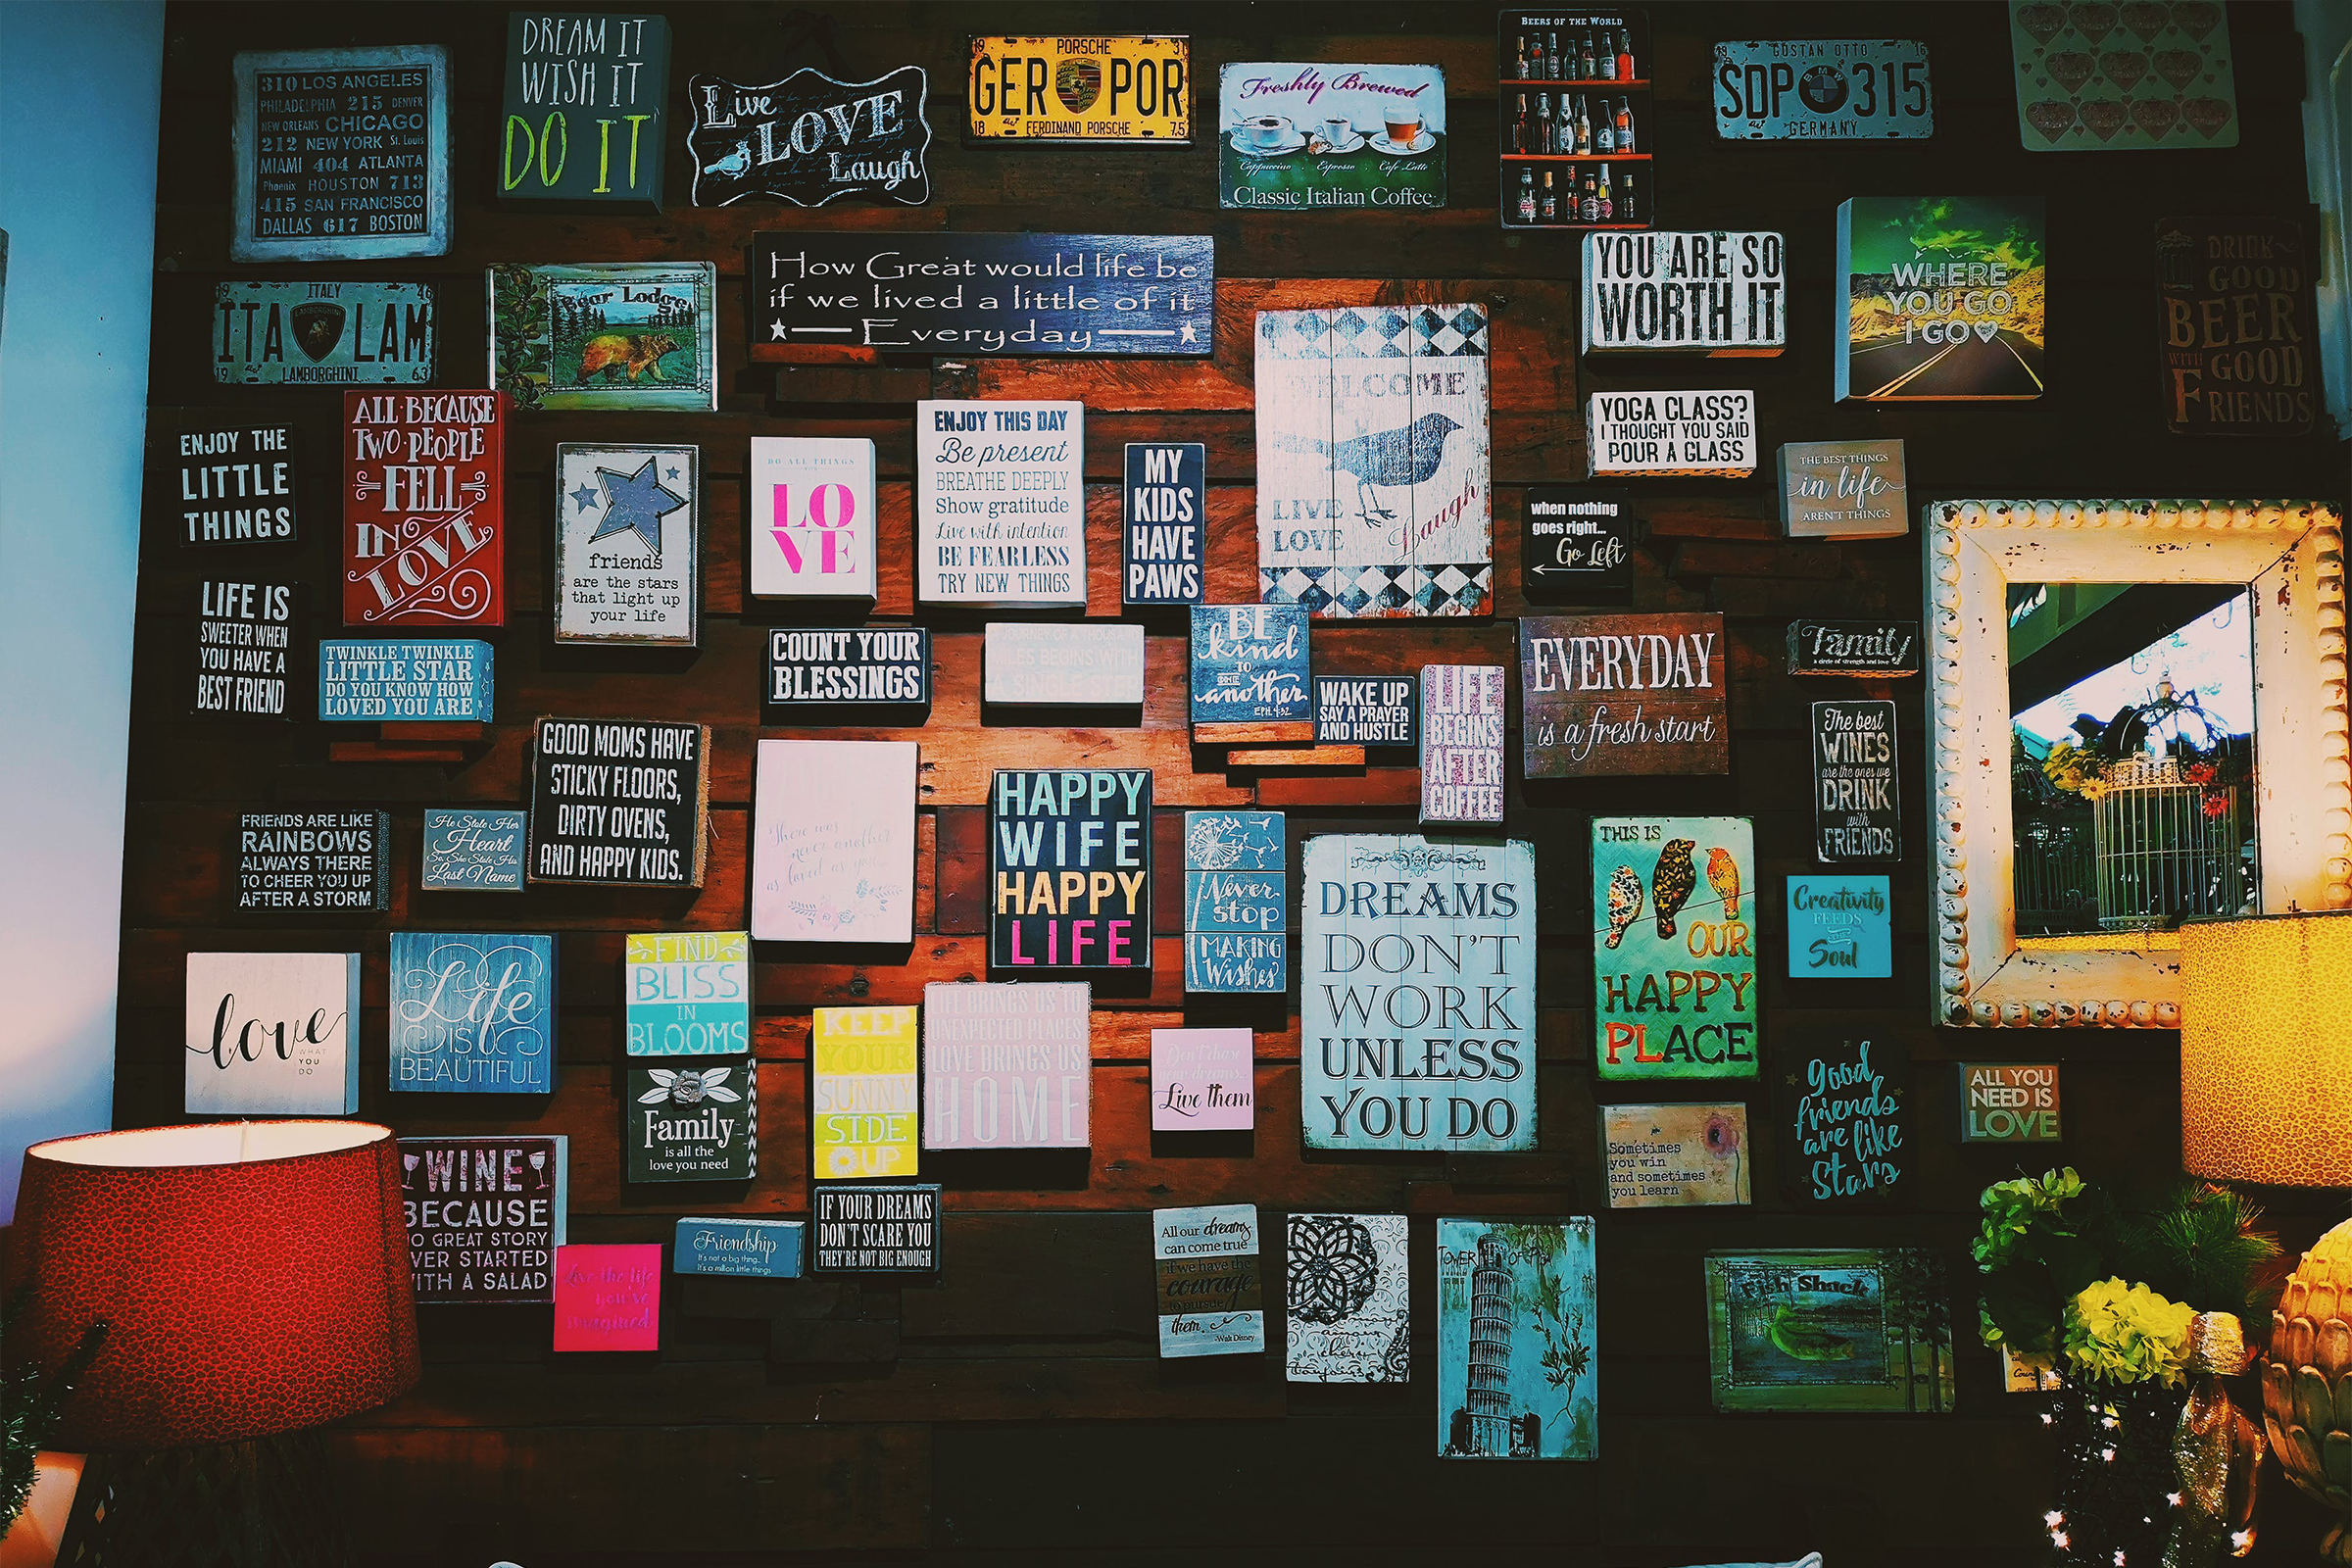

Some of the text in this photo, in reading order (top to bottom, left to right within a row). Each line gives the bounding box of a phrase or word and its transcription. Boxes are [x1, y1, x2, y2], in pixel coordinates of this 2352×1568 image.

[522, 19, 647, 58] DREAM IT
[1056, 39, 1111, 54] PORSCHE
[262, 74, 423, 92] 310 LOS ANGELES
[520, 60, 643, 107] WISH IT
[974, 58, 1184, 117] GER POR
[1240, 67, 1430, 104] Freshly Brewed
[1719, 62, 1927, 119] SDP 315
[701, 85, 776, 128] Live
[757, 90, 903, 166] LOVE
[1026, 121, 1130, 135] FERDINAND PORSCHE
[1789, 121, 1858, 136] GERMANY
[261, 155, 423, 174] MIAMI 404 ATLANTA
[506, 111, 652, 192] DO IT
[1316, 161, 1355, 173] Espresso
[828, 150, 920, 191] Laugh
[1234, 186, 1433, 206] Classic Italian Coffee
[263, 214, 422, 234] DALLAS 617 BOSTON
[771, 251, 1198, 278] How Great would life be
[1597, 234, 1780, 278] YOU ARE SO
[1891, 262, 2008, 287] WHERE
[307, 283, 340, 299] ITALY
[621, 286, 694, 316] Lodge
[1886, 290, 2012, 316] YOU GO
[1598, 282, 1780, 342] WORTH IT
[2166, 294, 2303, 349] BEER
[218, 303, 429, 363] ITA LAM
[862, 318, 1093, 351] Everyday
[283, 367, 359, 382] LAMBORGHINI
[353, 394, 495, 424] ALL BECAUSE
[935, 411, 1068, 432] ENJOY THIS DAY
[1600, 395, 1748, 422] YOGA CLASS?
[180, 428, 287, 457] ENJOY THE
[1608, 440, 1743, 463] POUR A GLASS
[182, 463, 289, 500] LITTLE
[1145, 449, 1183, 484] MY
[382, 466, 462, 512] FELL
[1134, 487, 1194, 522] KIDS
[936, 497, 1069, 518] Show gratitude
[1531, 503, 1618, 516] when nothing
[1803, 509, 1891, 520] AREN'T THINGS
[184, 508, 290, 541] THINGS
[1132, 525, 1195, 561] HAVE
[589, 553, 662, 570] friends
[1130, 564, 1198, 599] PAWS
[203, 581, 290, 620] LIFE IS
[571, 591, 680, 608] that light up
[773, 632, 920, 662] COUNT YOUR
[1531, 633, 1715, 693] EVERYDAY
[198, 675, 284, 714] BEST FRIEND
[325, 683, 472, 697] DO YOU KNOW HOW
[773, 665, 920, 700] BLESSINGS
[1320, 682, 1409, 707] WAKE UP
[1320, 707, 1409, 722] SAY A PRAYER
[1431, 714, 1499, 746] BEGINS
[1821, 732, 1889, 763] WINES
[551, 764, 682, 805] STICKY FLOORS,
[999, 773, 1146, 816] HAPPY
[1823, 779, 1891, 811] DRINK
[1430, 786, 1499, 818] COFFEE
[242, 814, 372, 829] FRIENDS ARE LIKE
[242, 831, 371, 853] RAINBOWS
[1000, 820, 1140, 867] WIFE
[1825, 828, 1893, 856] FRIENDS
[540, 845, 683, 881] AND HAPPY KIDS.
[998, 871, 1145, 915] HAPPY
[1320, 881, 1518, 920] DREAMS
[1793, 884, 1885, 915] Creativity
[1012, 920, 1132, 965] LIFE
[636, 964, 740, 1001] BLISS
[1603, 973, 1752, 1012] HAPPY
[1321, 985, 1521, 1030] WORK
[628, 1023, 746, 1055] BLOOMS
[1605, 1022, 1752, 1064] PLACE
[400, 1057, 541, 1084] BEAUTIFUL
[1320, 1038, 1523, 1081] UNLESS
[1320, 1087, 1518, 1140] YOU DO
[1971, 1088, 2053, 1107] NEED IS
[644, 1108, 734, 1148] Family
[825, 1116, 906, 1144] SIDE
[1969, 1110, 2058, 1139] LOVE
[425, 1150, 522, 1193] WINE
[650, 1158, 728, 1173] love you need
[1611, 1171, 1705, 1183] and sometimes
[820, 1222, 931, 1247] DON'T SCARE YOU
[1161, 1221, 1251, 1243] All our dreams
[1796, 1275, 1869, 1298] Shack
